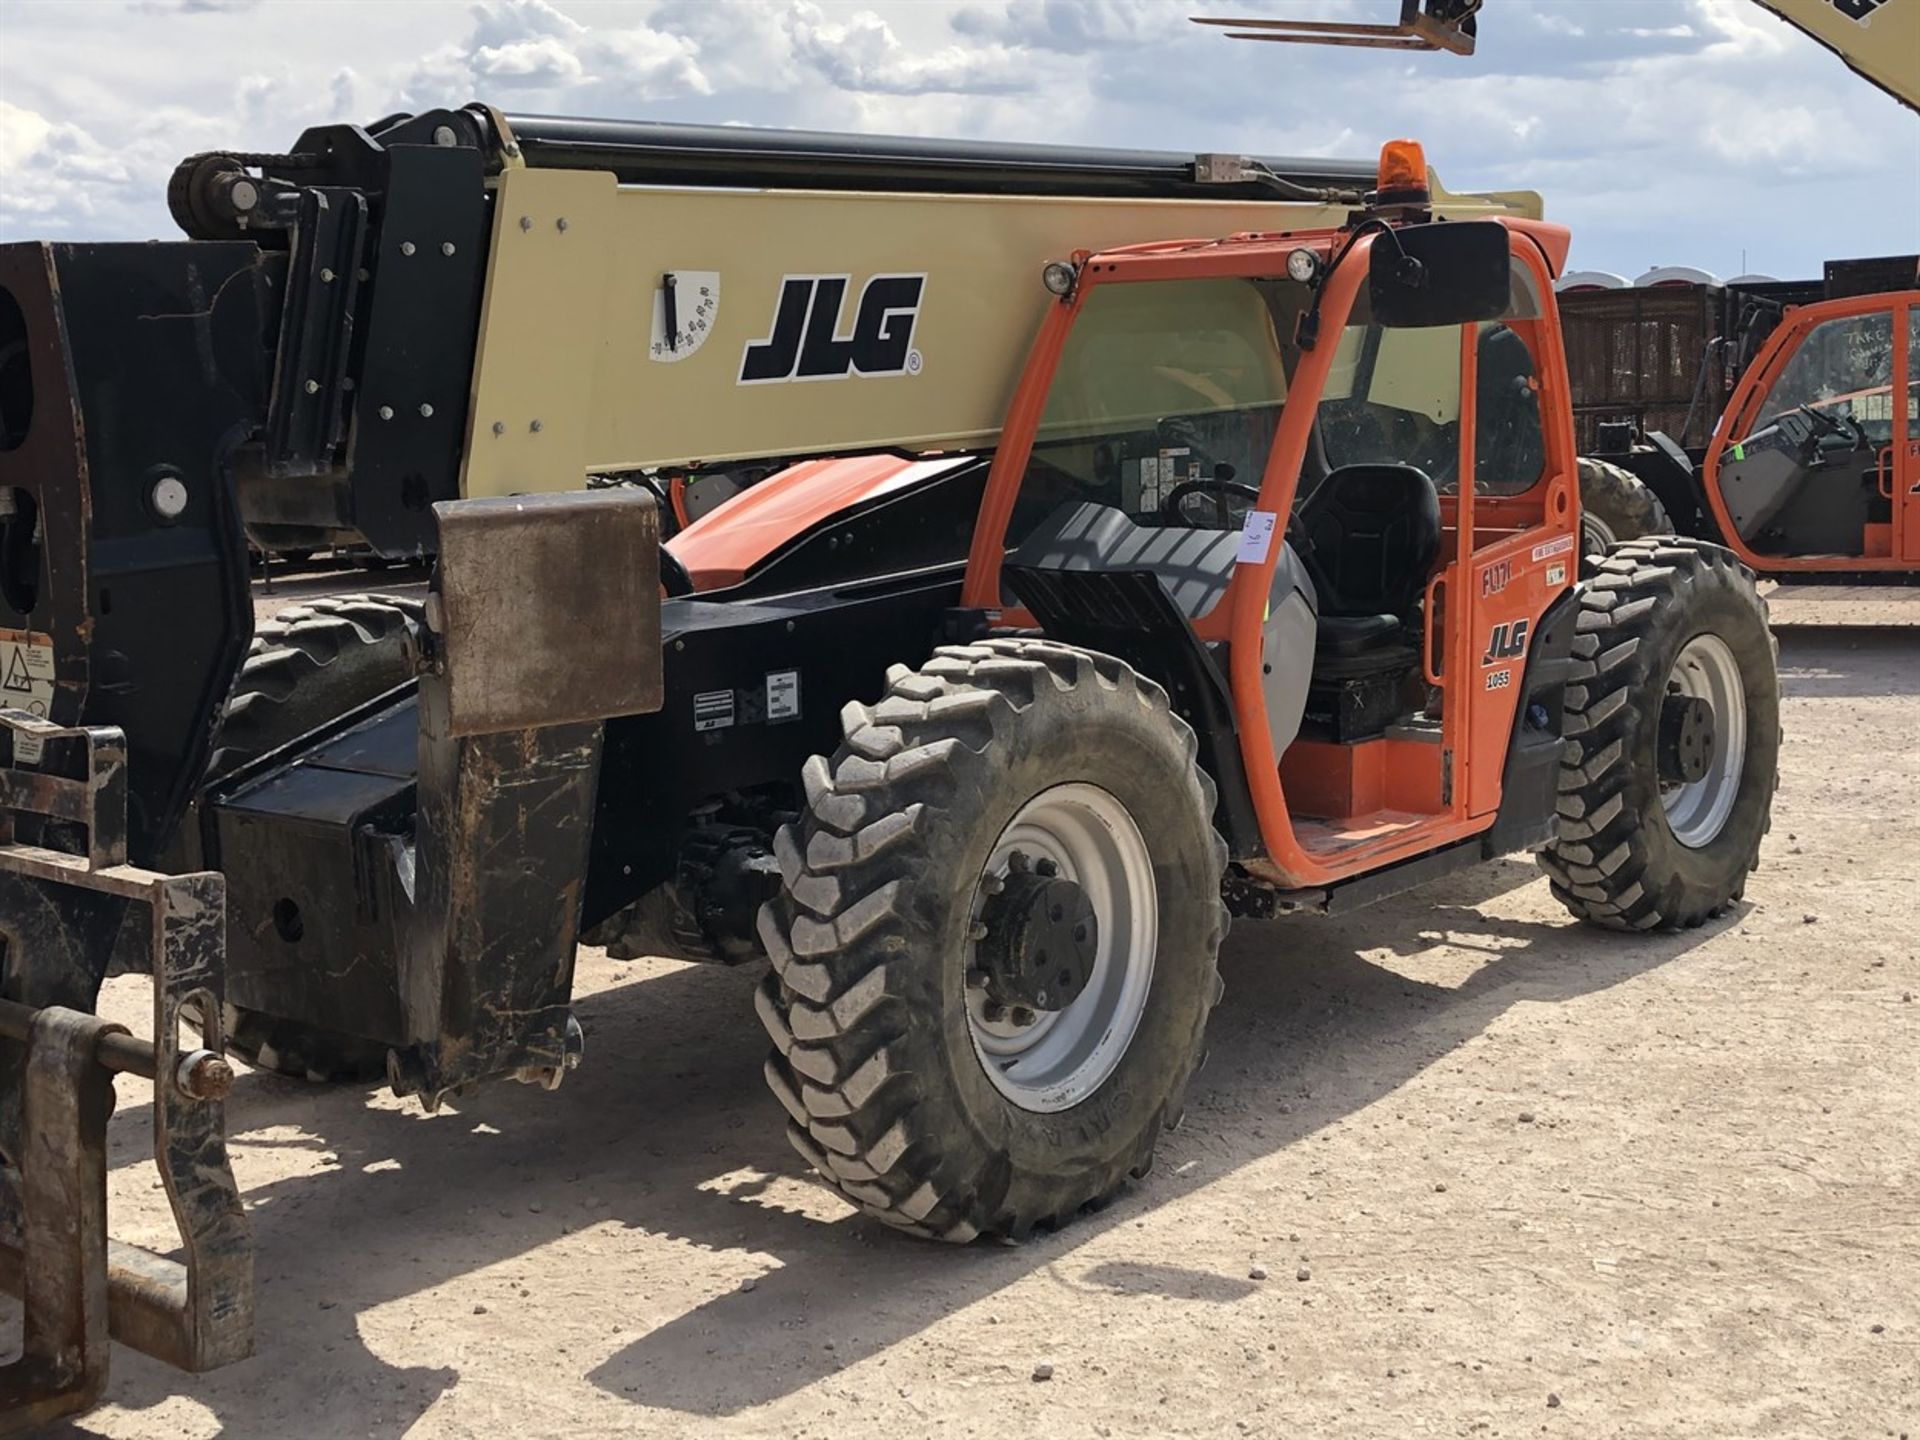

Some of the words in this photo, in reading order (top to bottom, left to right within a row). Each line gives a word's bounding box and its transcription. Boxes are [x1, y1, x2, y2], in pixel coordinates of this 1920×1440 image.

[738, 275, 926, 384] JLG
[1482, 619, 1529, 667] JLG
[1486, 670, 1510, 689] 1055
